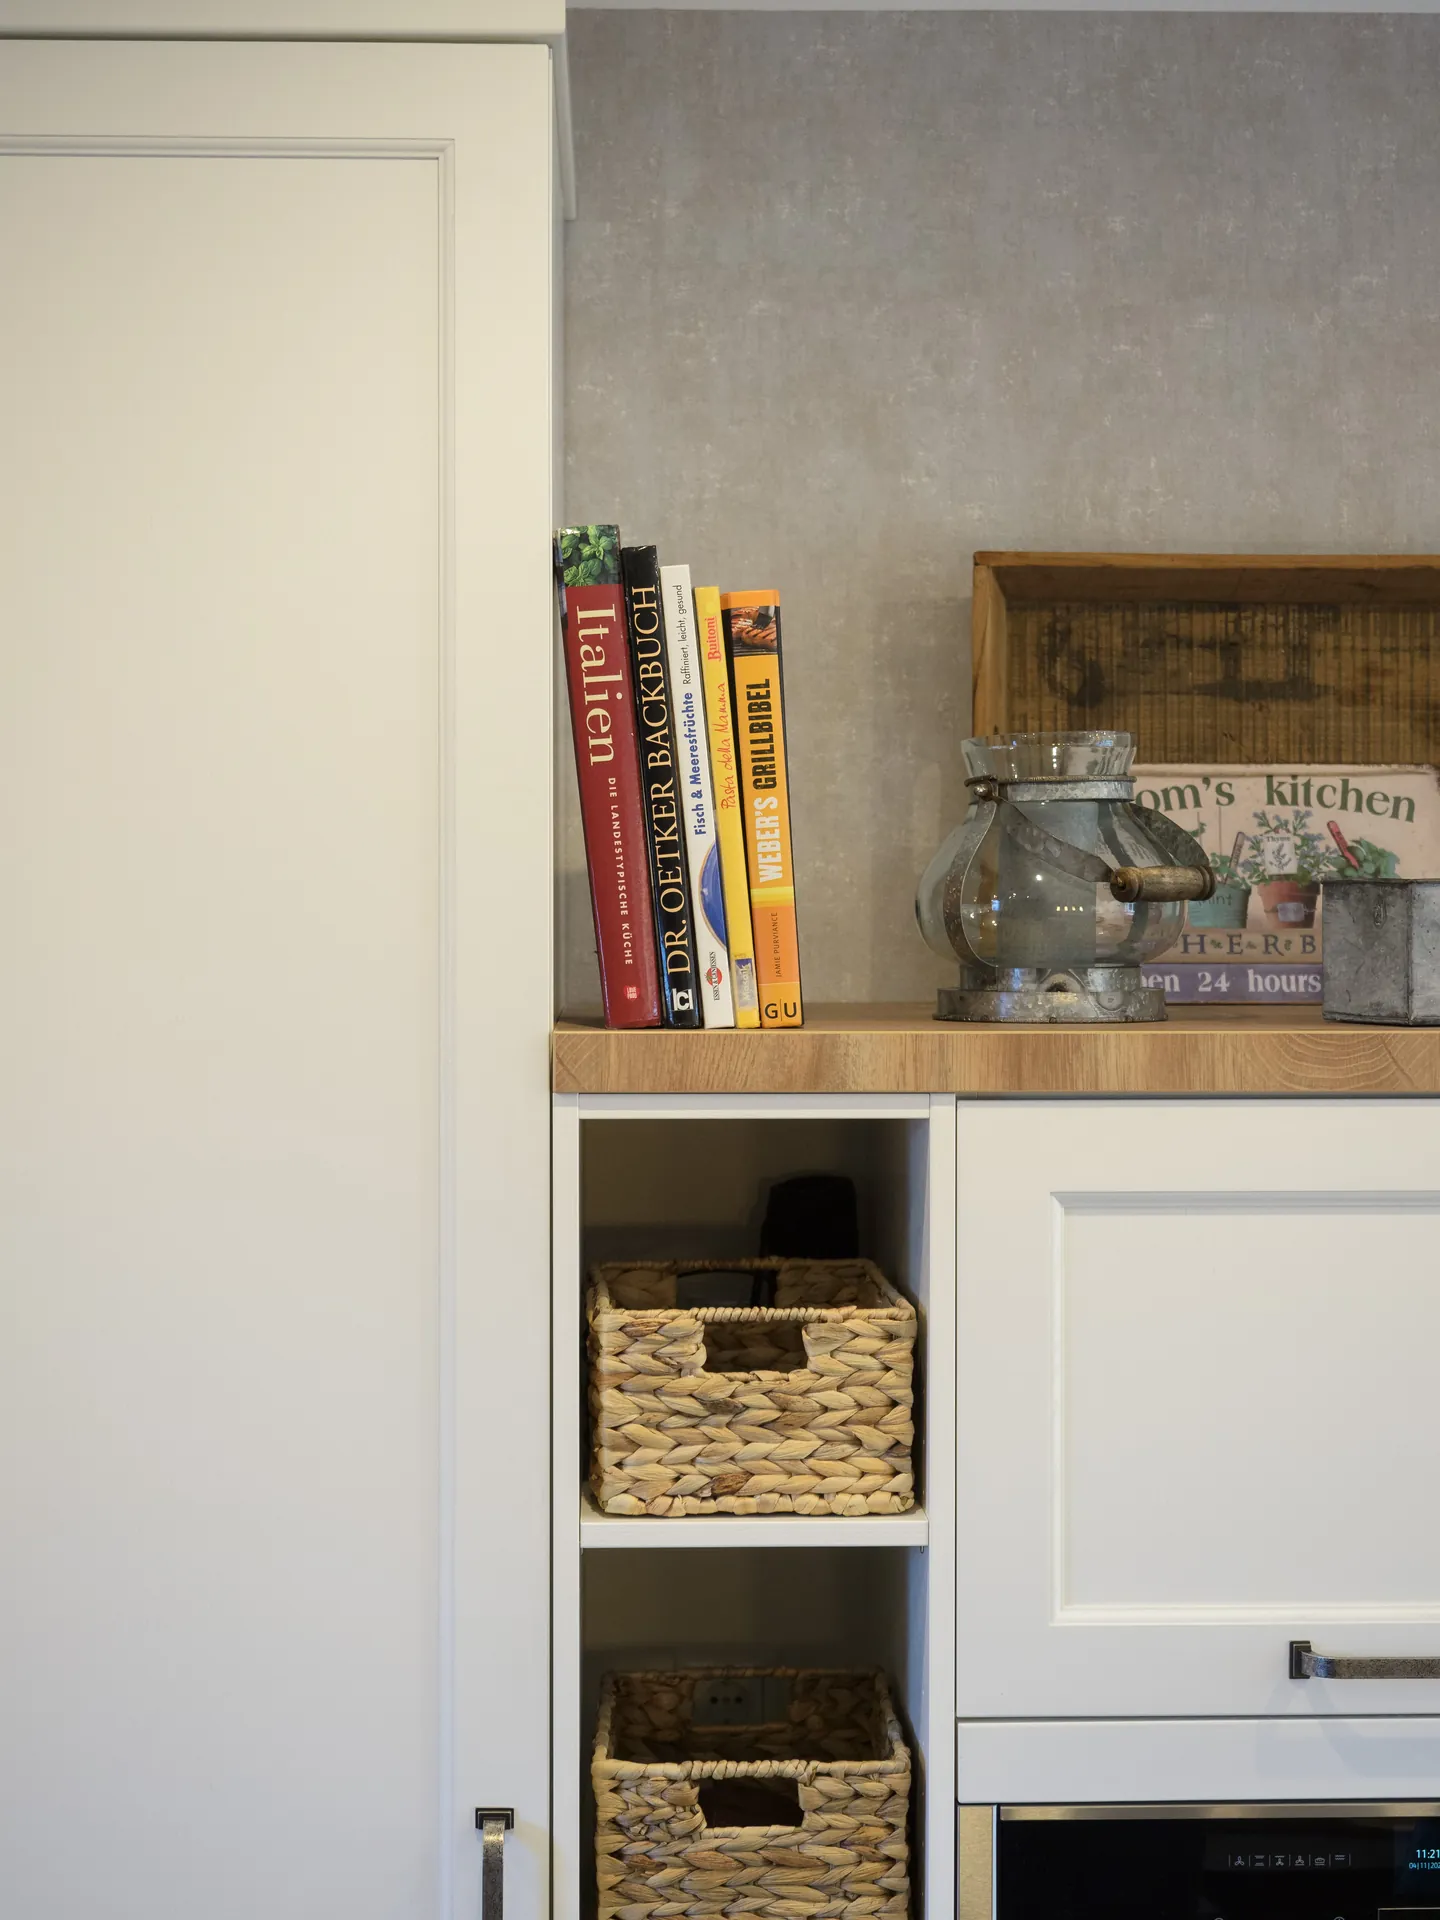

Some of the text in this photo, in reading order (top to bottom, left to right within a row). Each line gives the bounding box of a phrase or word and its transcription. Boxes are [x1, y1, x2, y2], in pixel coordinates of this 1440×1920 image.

[576, 604, 623, 766] Italien
[673, 584, 691, 685] Raffiniert, leicht, gesund
[704, 617, 722, 662] Buitoni
[631, 585, 691, 975] DR. OETKER BACKBUCH
[681, 692, 706, 836] Fisch & Meeresfrüchte
[715, 682, 736, 811] Pasta della Mamma
[745, 678, 782, 883] WEBER'S GRILLBIBEL
[1135, 775, 1416, 823] om's kitchen
[608, 777, 633, 965] DIE LANDESTYPISCHE KÜCHE
[712, 985, 720, 1001] ESSEN
[770, 912, 782, 977] JAMIE PURVIANCE
[1198, 971, 1230, 993] 24
[1247, 969, 1322, 993] hours
[1416, 1849, 1440, 1859] 11:21
